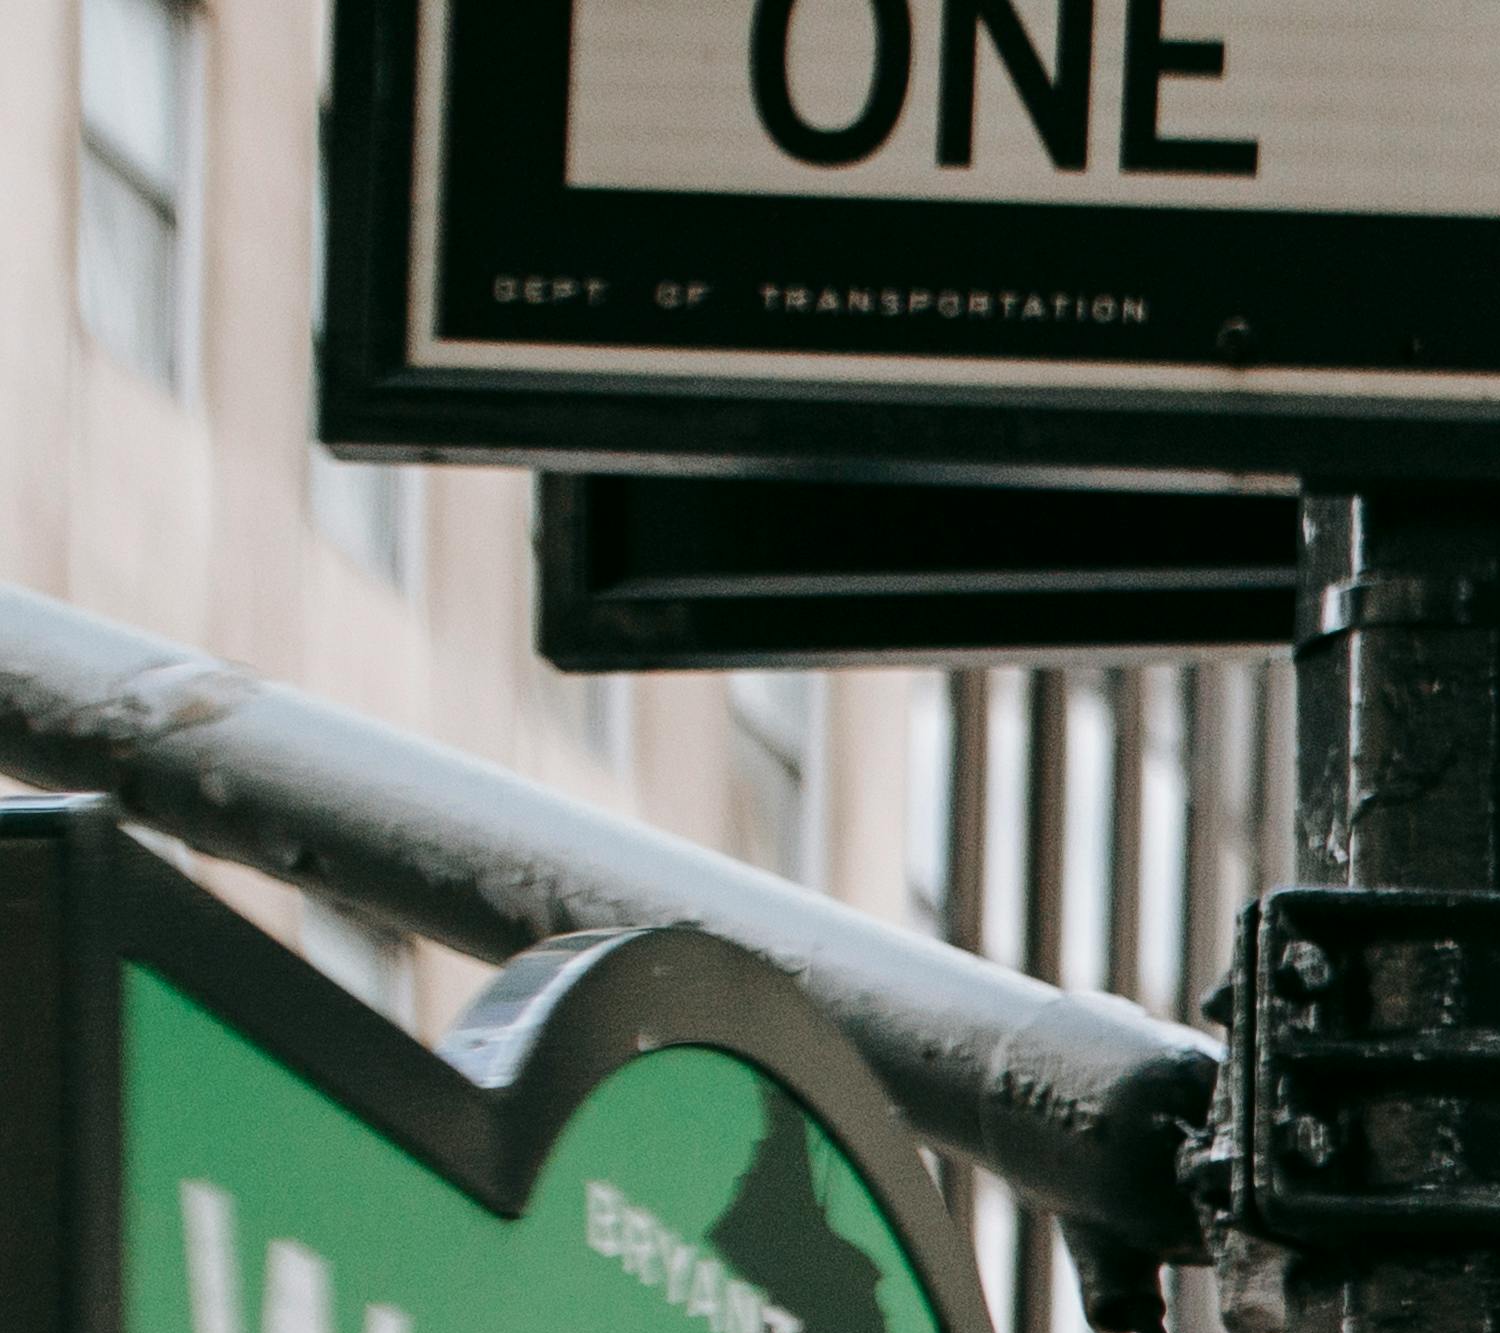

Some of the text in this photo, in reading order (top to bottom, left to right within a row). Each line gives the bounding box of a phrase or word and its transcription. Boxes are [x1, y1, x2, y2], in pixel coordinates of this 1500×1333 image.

[747, 0, 1259, 178] ONE
[493, 275, 1149, 324] DEPT OF TRANSPORTATION
